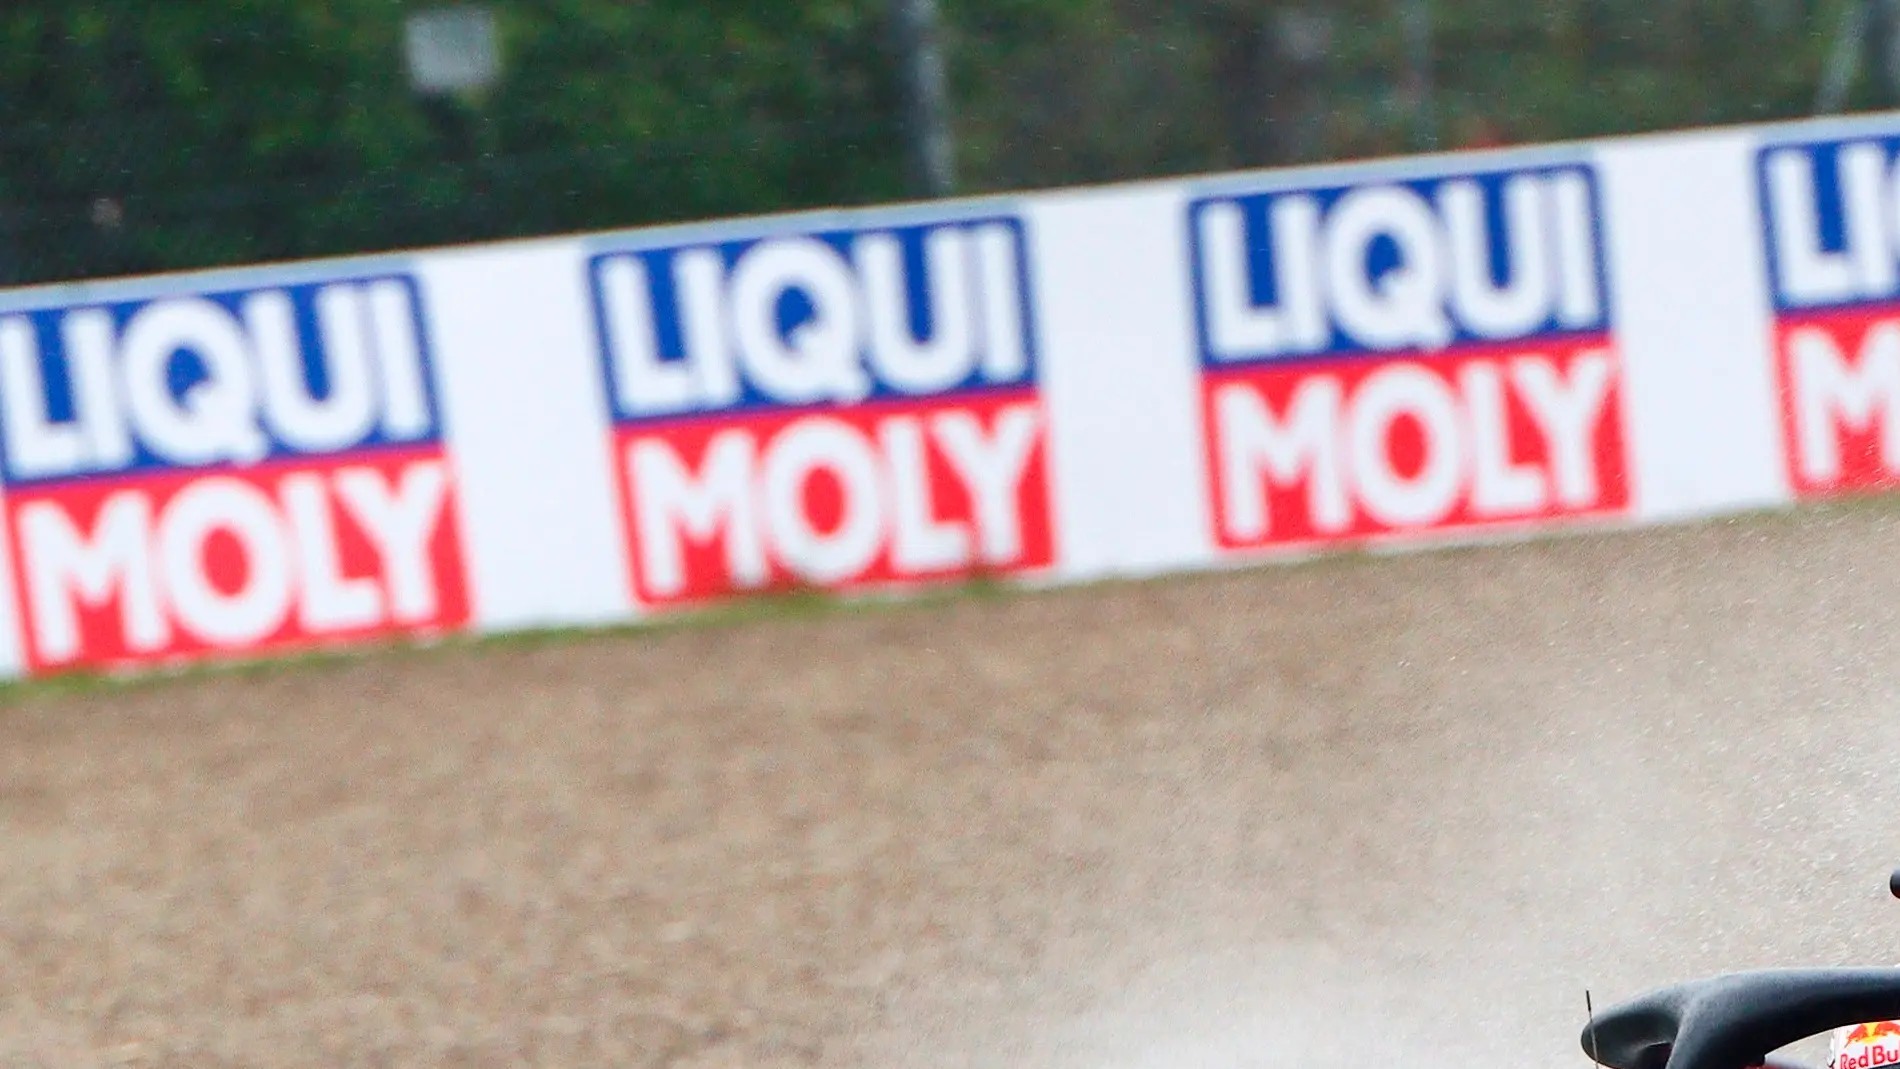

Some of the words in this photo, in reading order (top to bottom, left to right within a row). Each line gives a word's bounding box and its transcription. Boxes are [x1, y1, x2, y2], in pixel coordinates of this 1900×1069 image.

[601, 219, 1025, 416] LIQUI
[1203, 170, 1600, 361] LIQUI
[0, 276, 432, 476] LIQUI
[1214, 348, 1617, 542] MOLY
[17, 459, 452, 662] MOLY
[625, 408, 1046, 594] MOLY
